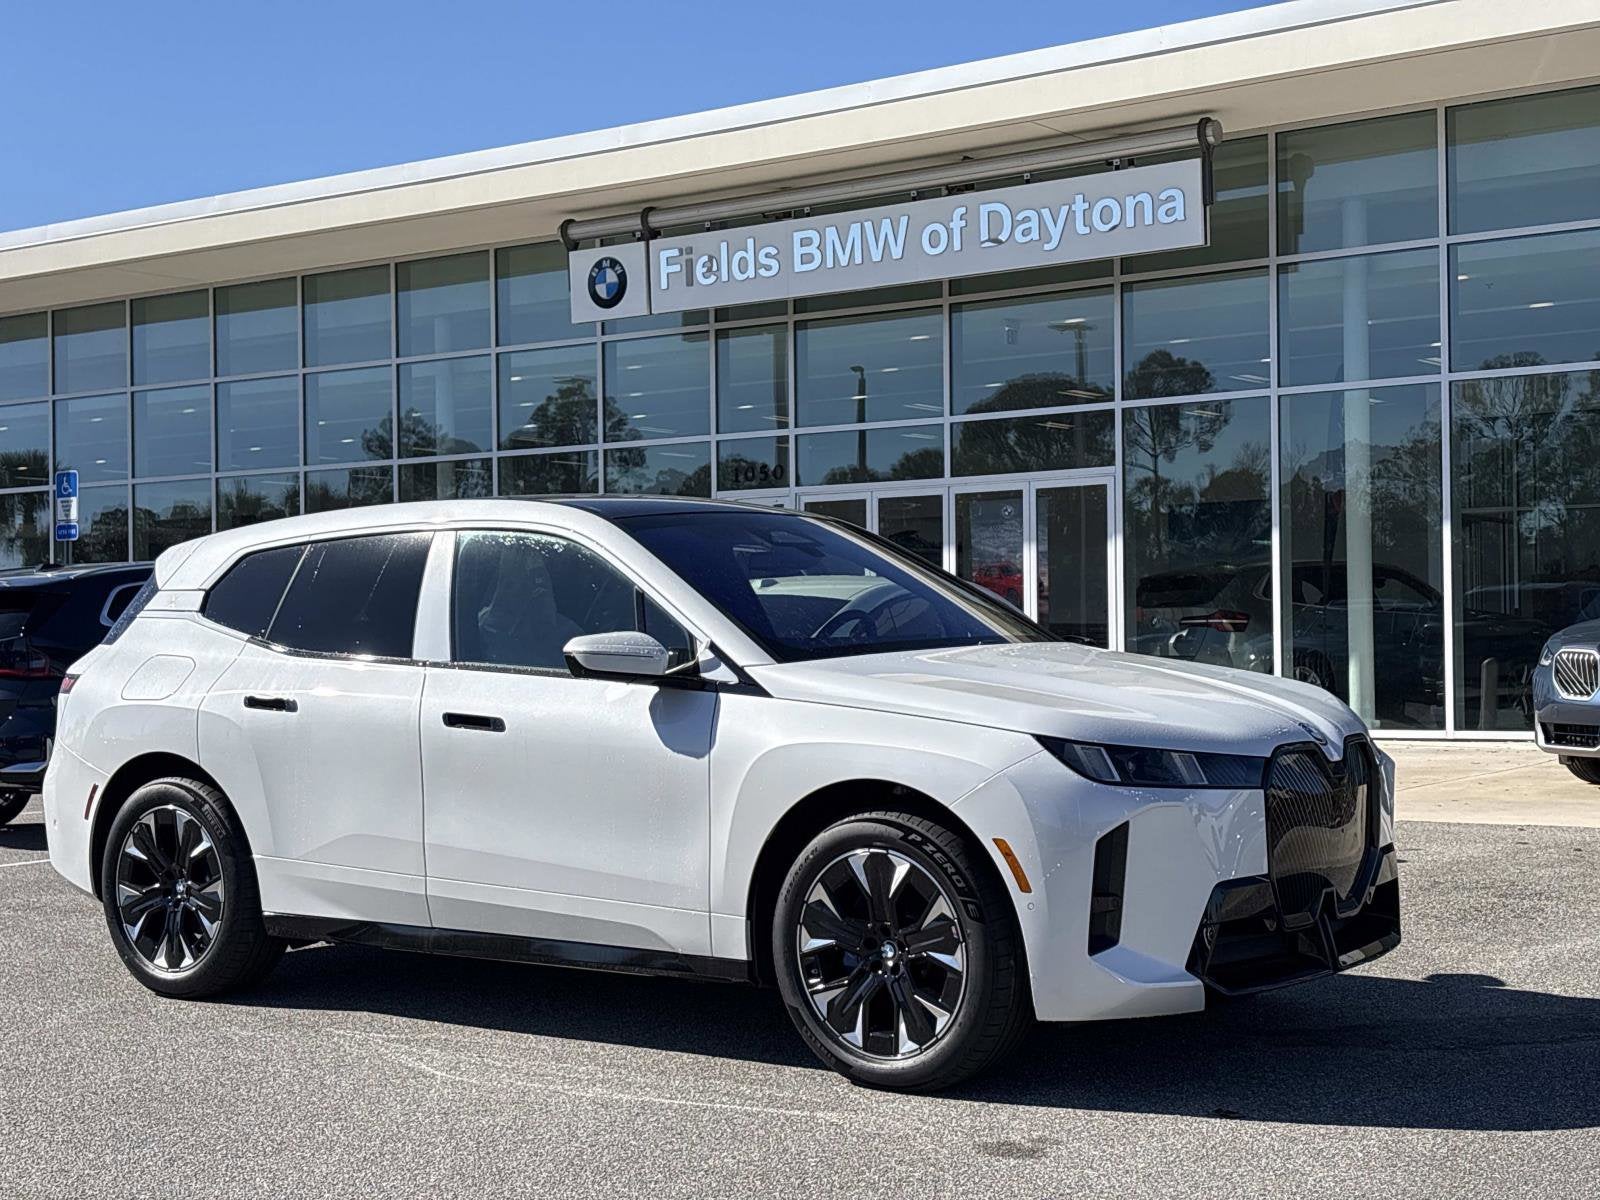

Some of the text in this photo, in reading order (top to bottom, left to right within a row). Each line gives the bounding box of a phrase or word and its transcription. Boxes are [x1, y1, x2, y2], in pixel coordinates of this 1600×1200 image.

[659, 187, 1186, 290] Fields BMW of Daytona
[734, 463, 784, 482] 1050
[922, 842, 966, 888] ZERO
